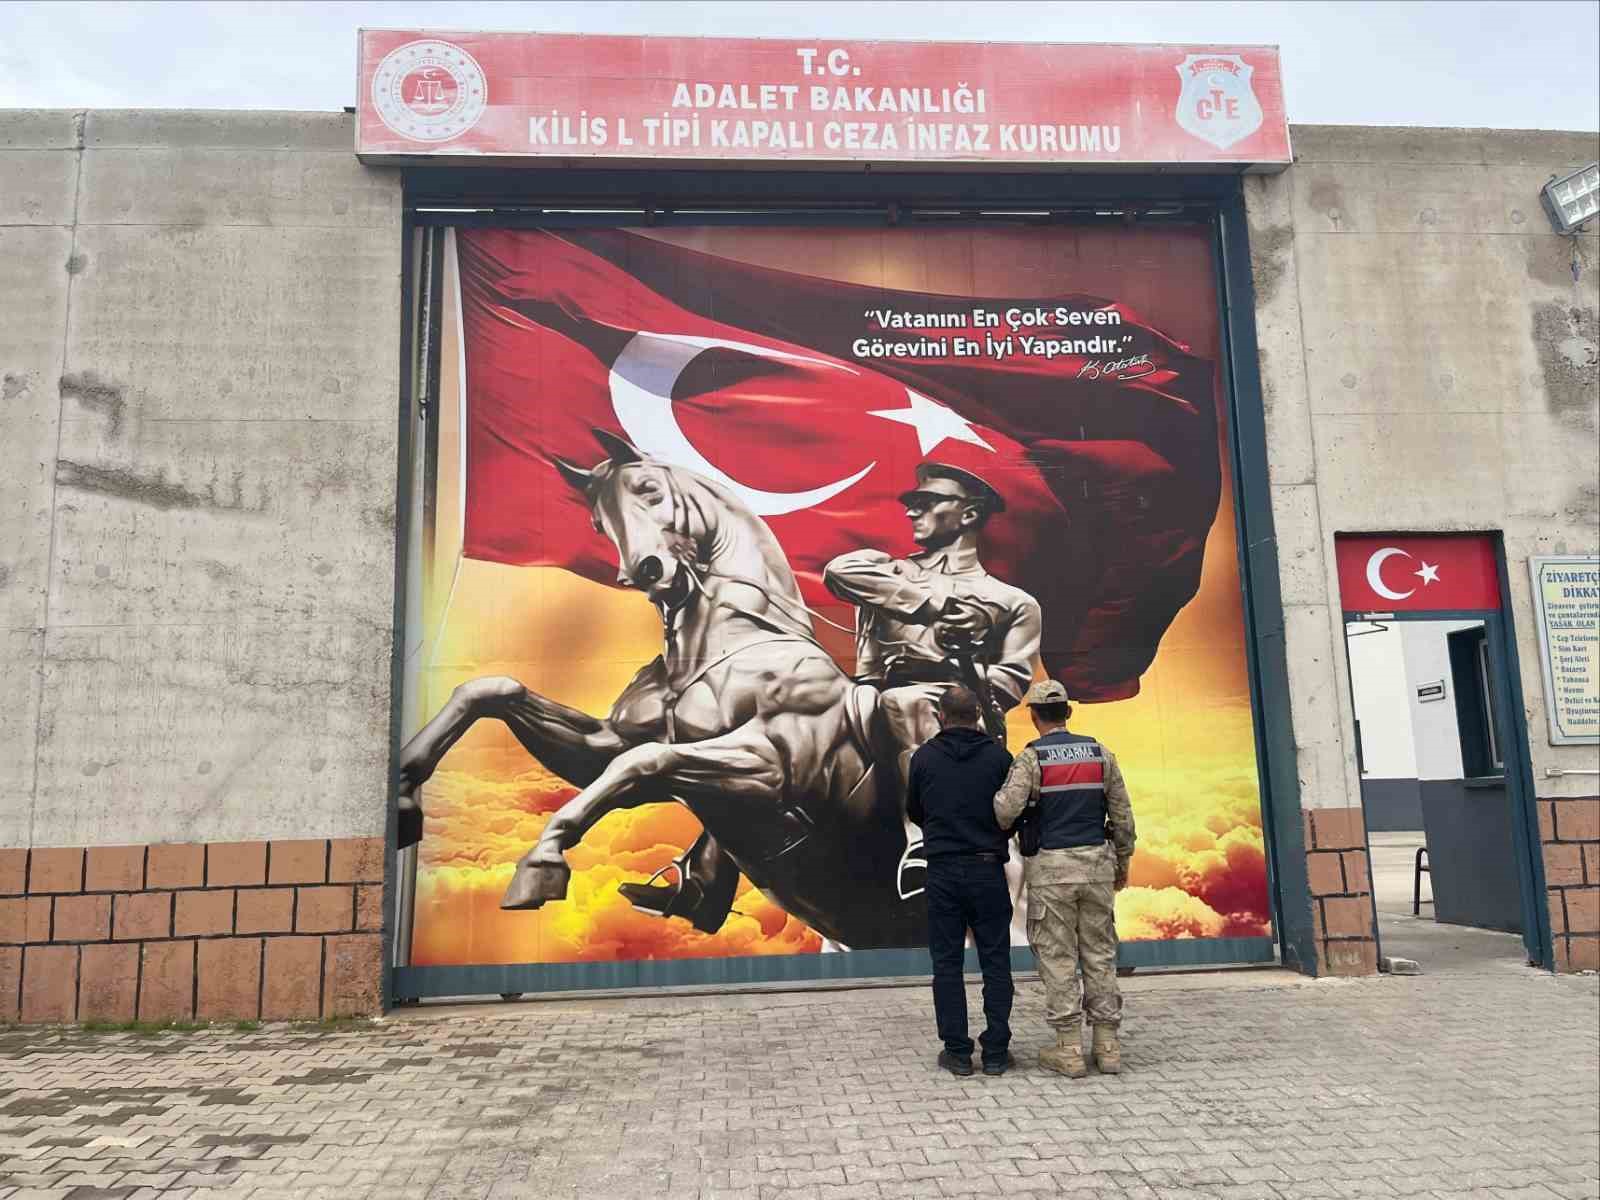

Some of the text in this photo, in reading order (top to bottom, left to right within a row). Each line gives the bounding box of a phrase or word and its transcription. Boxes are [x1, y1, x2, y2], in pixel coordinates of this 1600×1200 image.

[796, 48, 862, 76] T.C.
[671, 81, 986, 114] ADALET BAKANLIĞI
[528, 110, 1121, 153] KİLİS L TİPİ KAPALI CEZA İNFAZ KURUMU
[973, 309, 999, 328] En
[1005, 308, 1049, 332] Çok
[1055, 307, 1121, 326] Seven
[852, 338, 947, 358] Görevini
[953, 338, 979, 356] En
[985, 332, 1013, 359] İyi
[1546, 570, 1600, 585] ZİYARETÇ
[1046, 746, 1093, 761] JANDARMA
